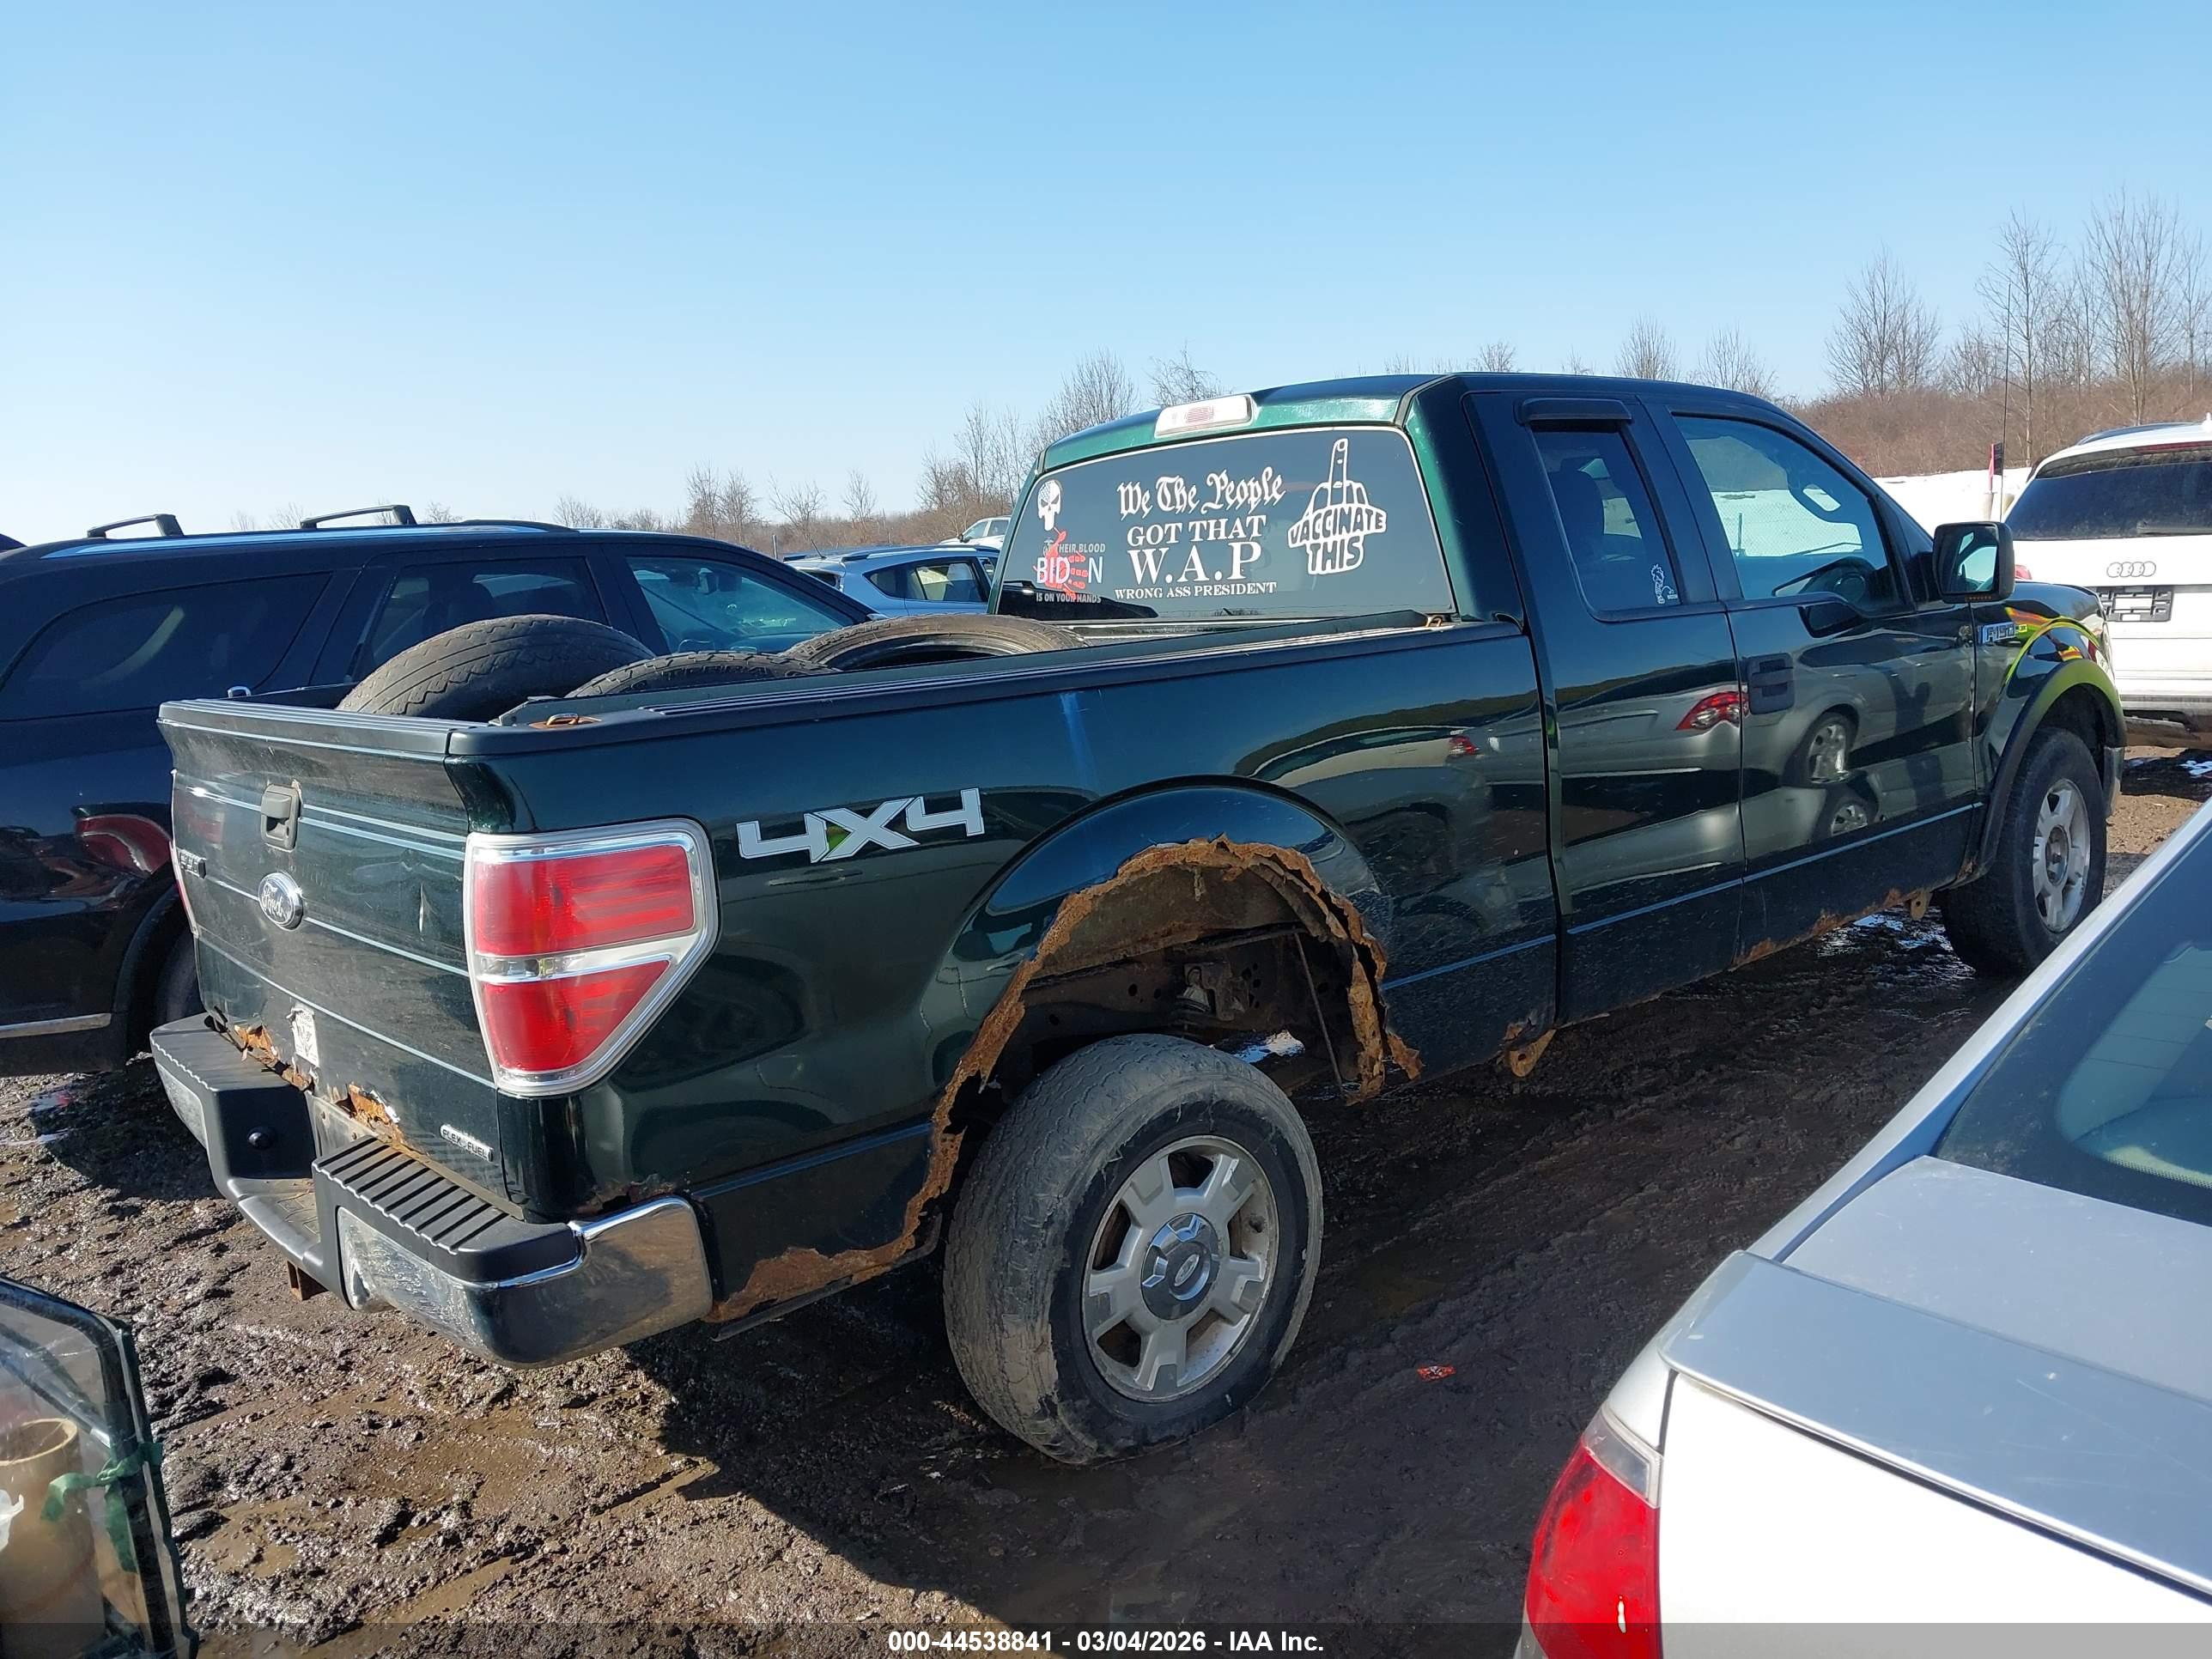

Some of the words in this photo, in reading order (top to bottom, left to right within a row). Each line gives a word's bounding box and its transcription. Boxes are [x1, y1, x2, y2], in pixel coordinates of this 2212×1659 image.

[1117, 482, 1152, 521] We
[1156, 475, 1200, 514] The
[1201, 466, 1285, 514] People
[1127, 522, 1182, 546] GOT
[1188, 515, 1267, 541] THAT
[1290, 506, 1384, 545] VACCINATE
[1054, 543, 1077, 553] HEIR
[1079, 543, 1106, 553] BLOOD
[1310, 535, 1361, 572] THIS
[1036, 592, 1042, 602] IS
[1044, 592, 1055, 602] ON
[1077, 593, 1102, 604] HANDS
[1115, 587, 1164, 600] WRONG
[1166, 586, 1191, 599] ASS
[1194, 581, 1278, 597] PRESIDENT
[262, 881, 288, 921] Ford
[442, 1128, 461, 1144] FLEX
[467, 1141, 488, 1159] FUEL
